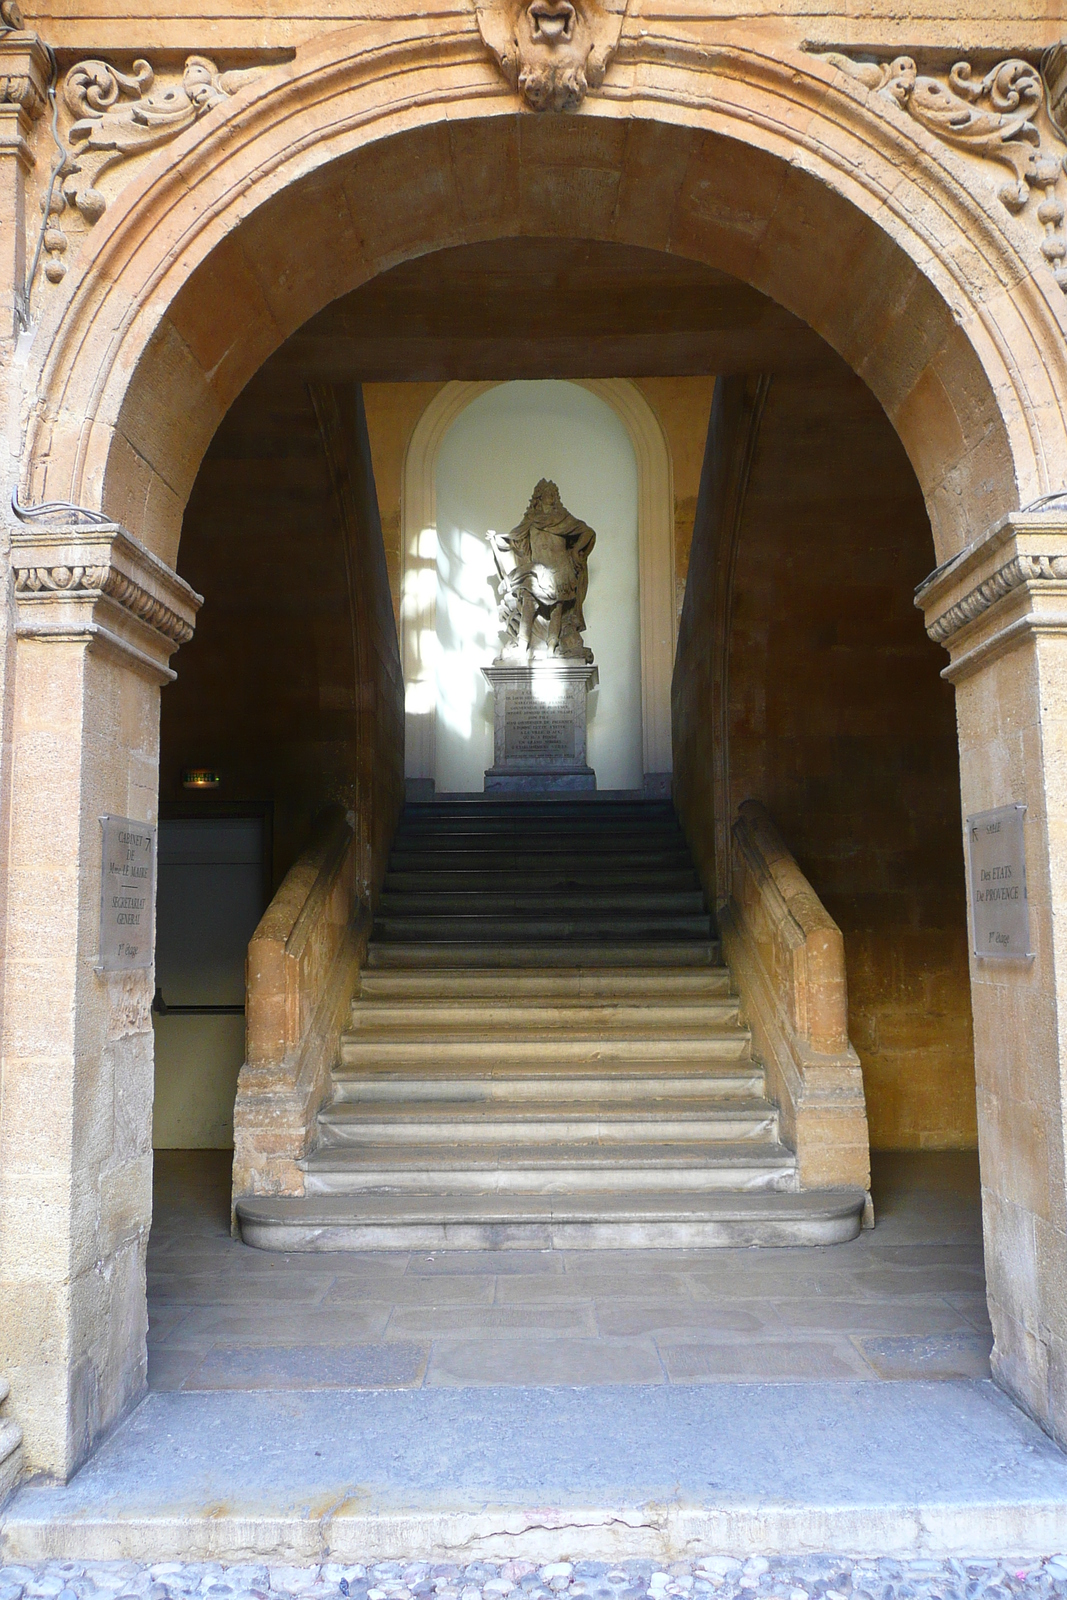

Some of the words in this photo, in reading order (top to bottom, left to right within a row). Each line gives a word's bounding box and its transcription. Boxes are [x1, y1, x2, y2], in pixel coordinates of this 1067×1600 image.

[118, 831, 143, 847] CABINET
[126, 849, 135, 861] DE
[122, 864, 130, 876] LE
[131, 866, 148, 879] MAIRE
[980, 869, 991, 882] Des
[992, 865, 1012, 880] ETATS
[976, 890, 985, 902] De
[986, 886, 1019, 901] PROVENCE
[112, 896, 146, 909] SECRETARIAT
[116, 913, 141, 925] GENERAL
